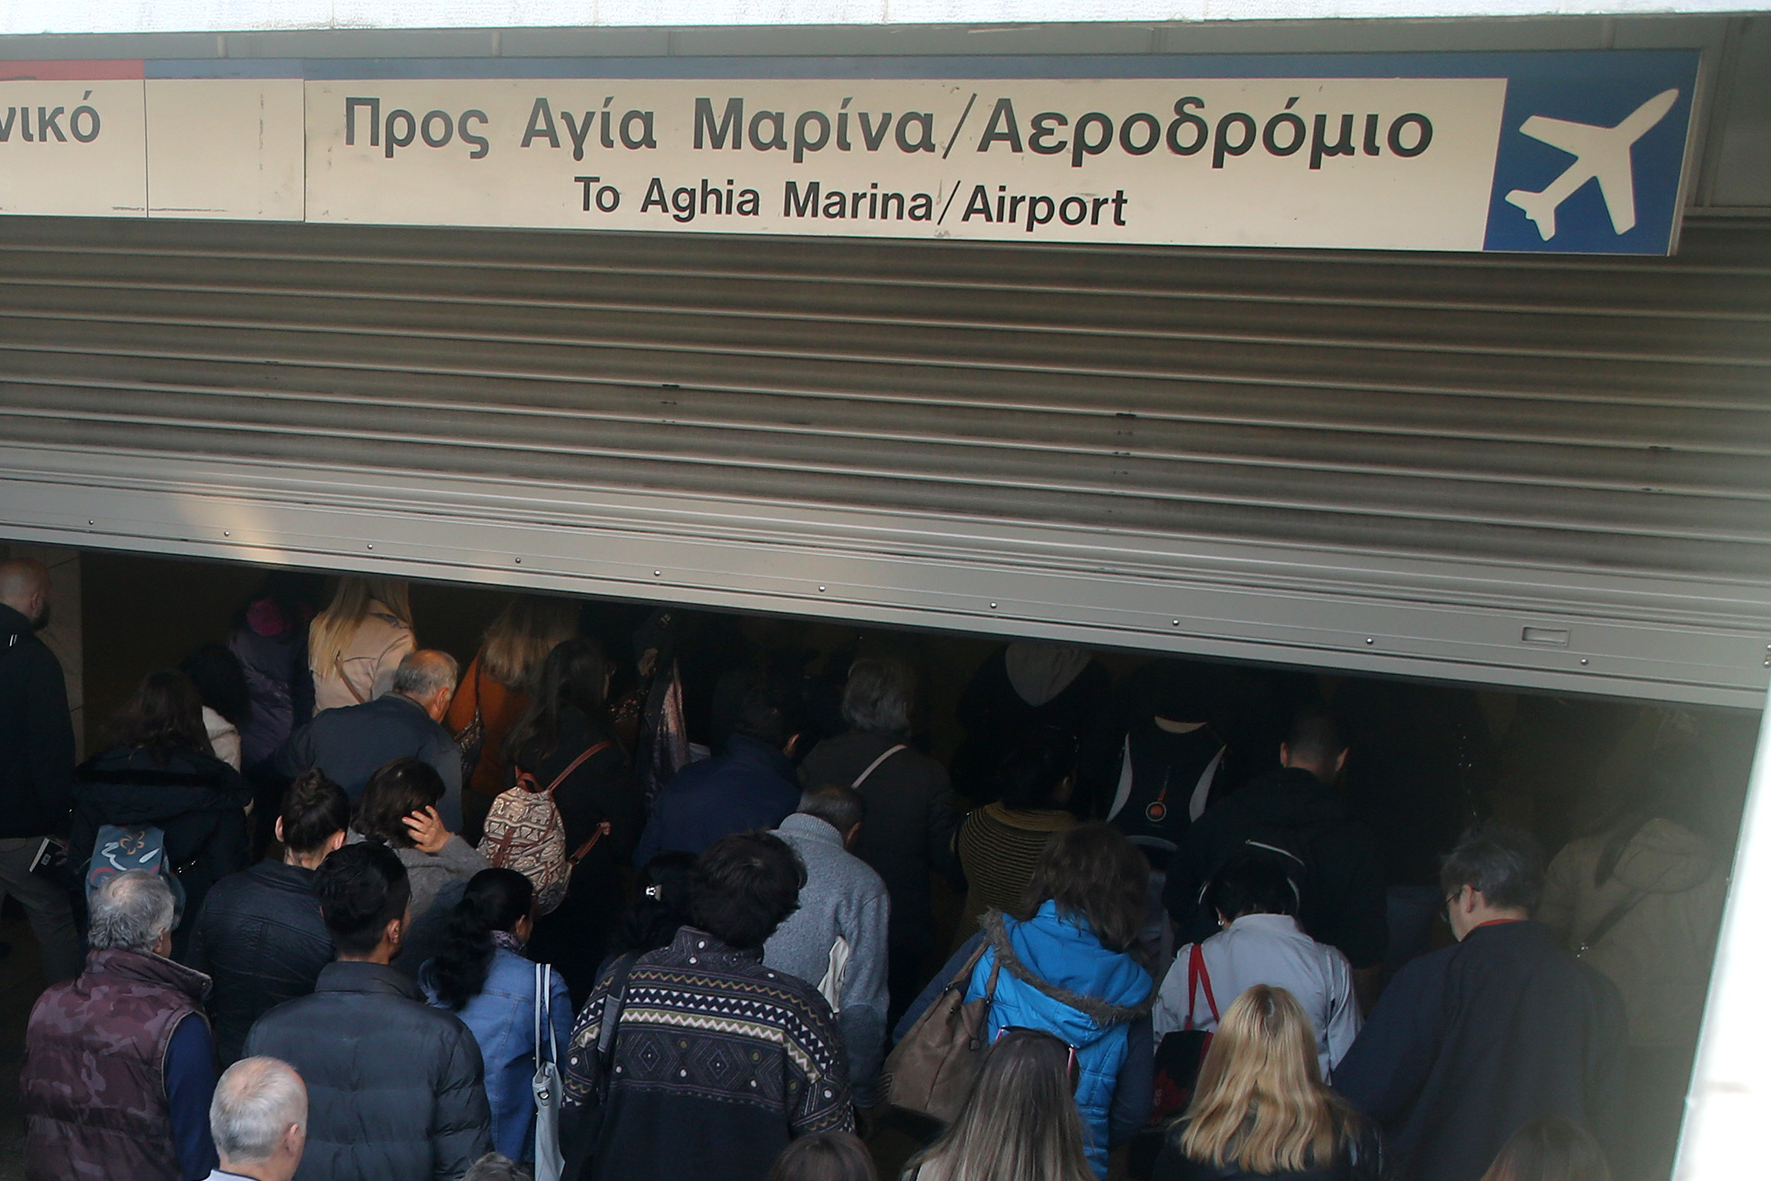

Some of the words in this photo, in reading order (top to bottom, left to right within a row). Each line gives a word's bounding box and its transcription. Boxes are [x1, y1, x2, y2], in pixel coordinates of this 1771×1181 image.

[345, 96, 490, 160] Προς
[520, 95, 657, 162] Αγία
[573, 175, 621, 213] To
[639, 177, 760, 224] Aghia
